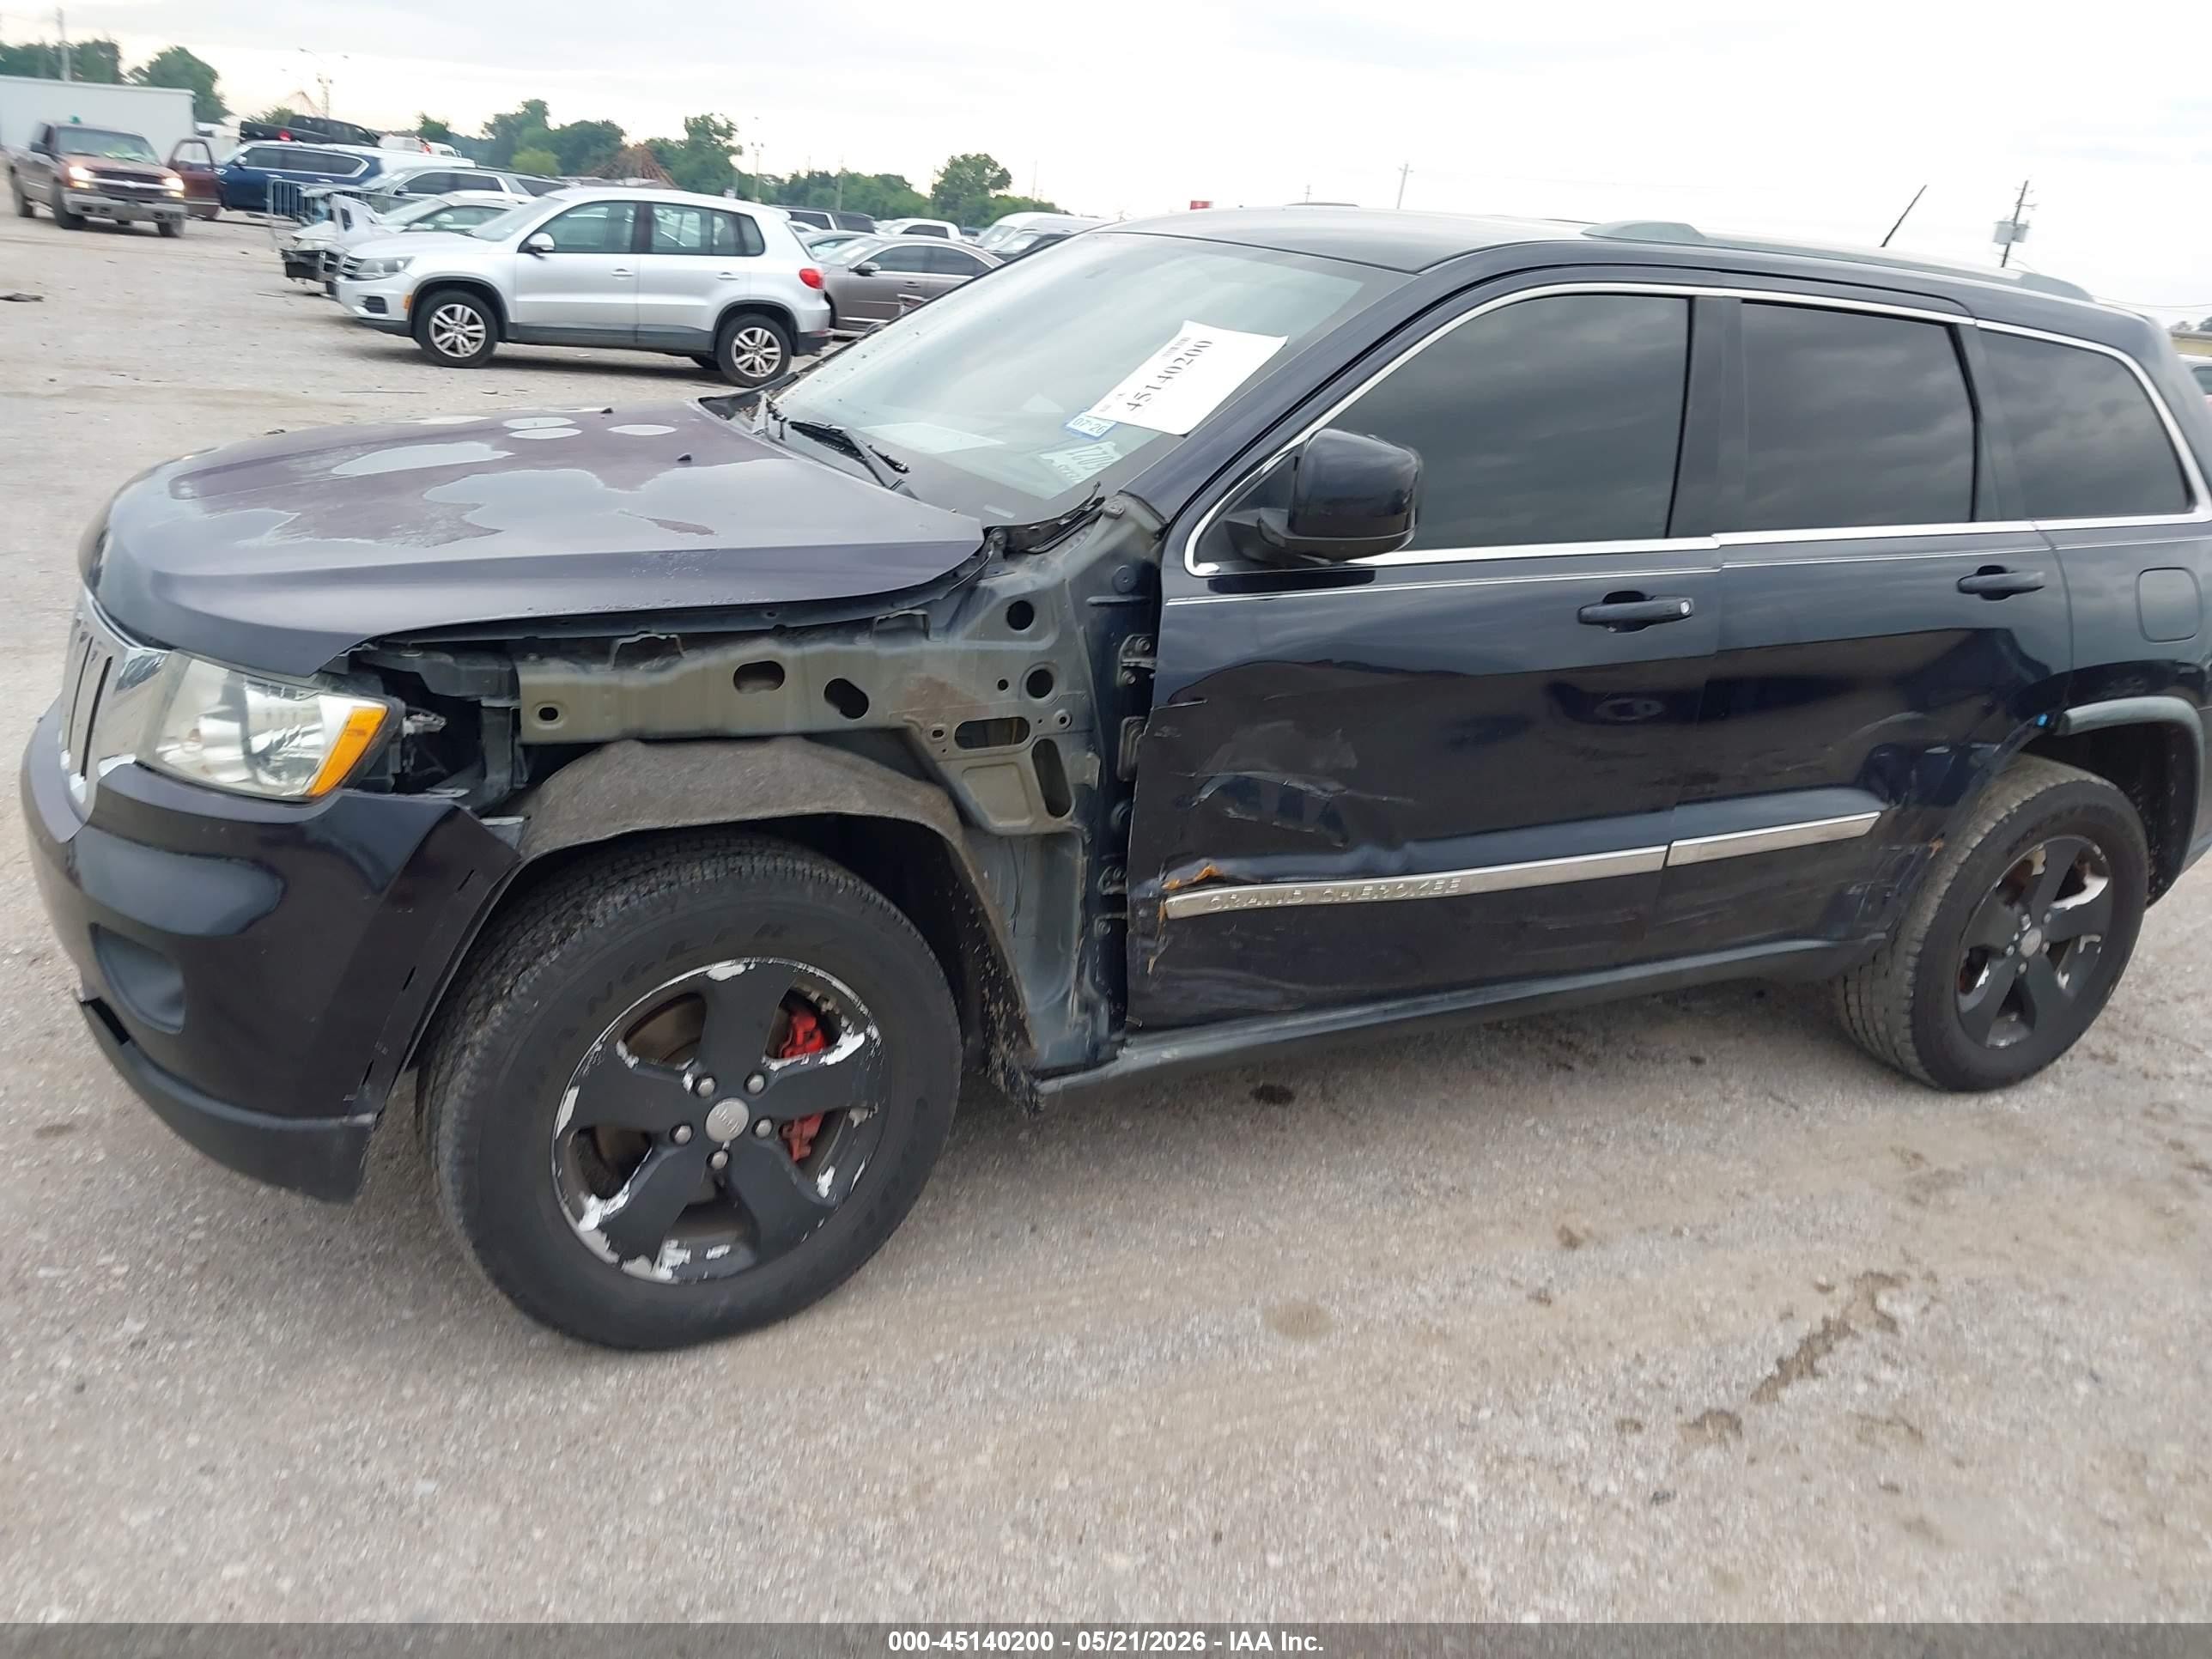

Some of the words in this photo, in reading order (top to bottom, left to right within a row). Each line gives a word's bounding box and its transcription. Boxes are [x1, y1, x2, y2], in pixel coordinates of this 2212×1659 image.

[1126, 340, 1213, 411] 45140200
[1208, 889, 1305, 911] GRAND
[1319, 878, 1462, 903] CHEROKEE
